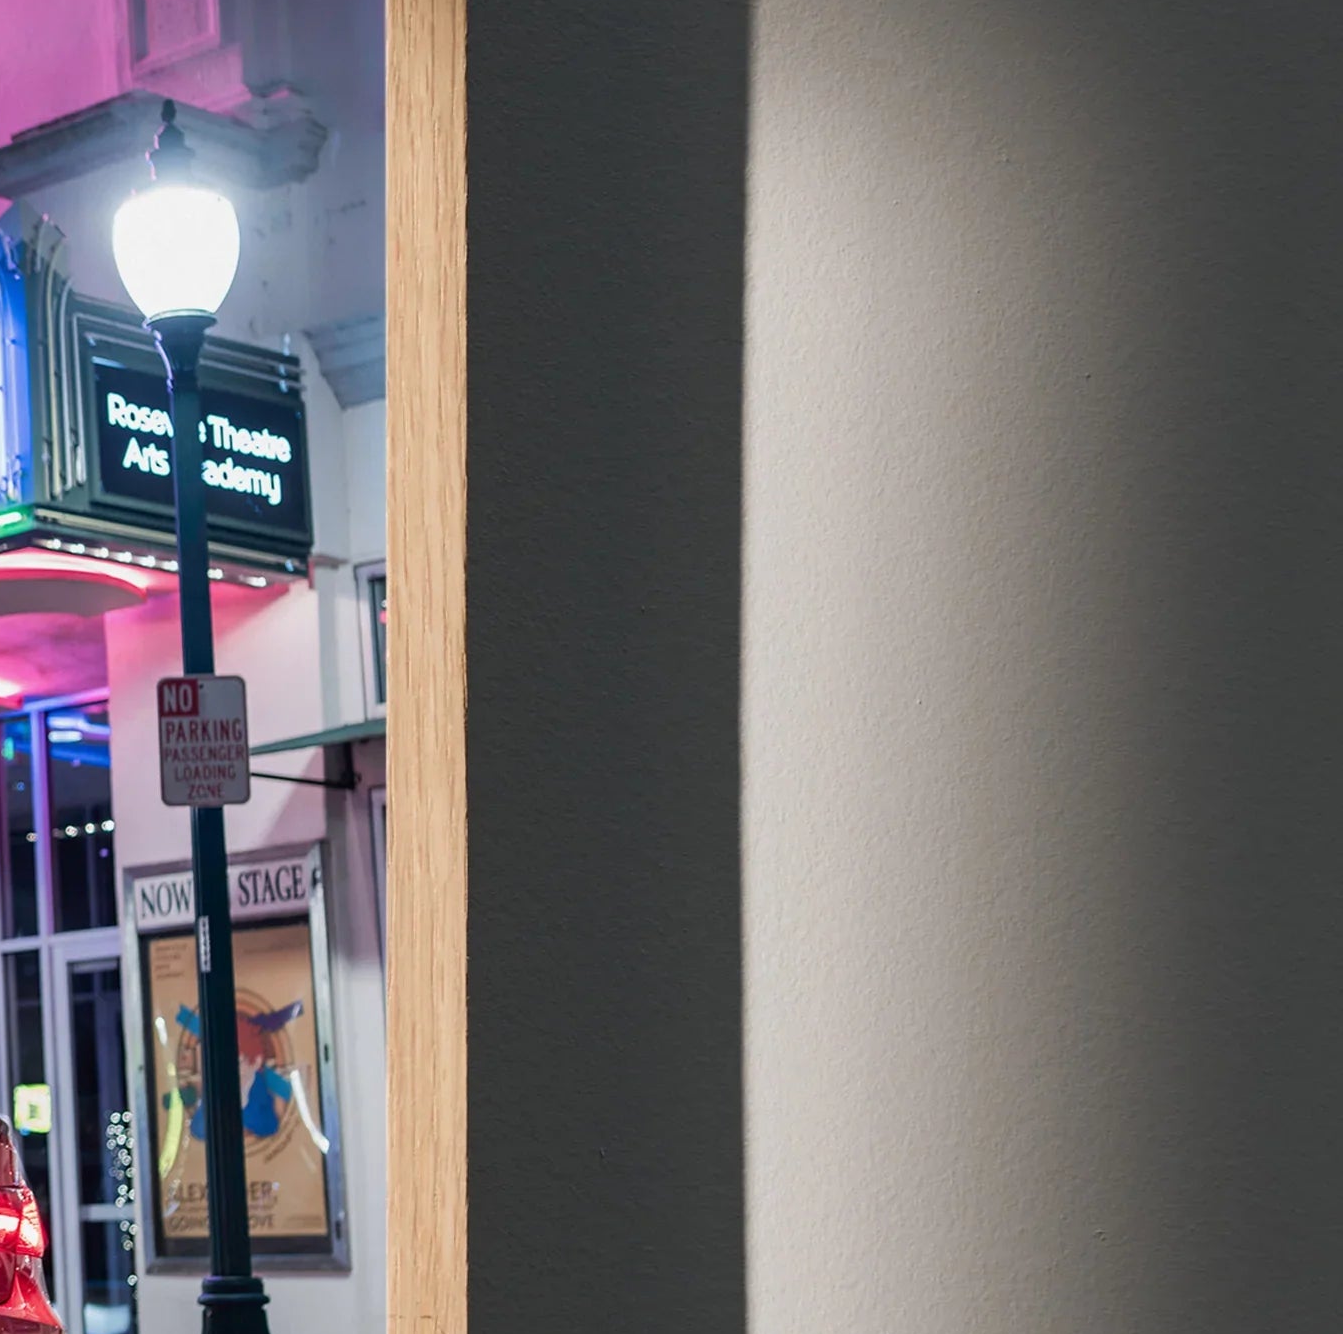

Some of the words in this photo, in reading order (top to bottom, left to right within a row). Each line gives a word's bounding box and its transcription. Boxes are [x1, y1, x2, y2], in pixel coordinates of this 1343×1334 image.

[207, 414, 292, 464] Theatre
[122, 436, 171, 477] Arts
[201, 457, 283, 506] ademy
[162, 683, 193, 713] NO
[165, 718, 243, 744] PARKING
[164, 744, 245, 762] PASSENGER
[174, 763, 237, 781] LOADING
[187, 782, 223, 800] ZONE
[141, 877, 193, 919] NOW
[238, 864, 306, 907] STAGE
